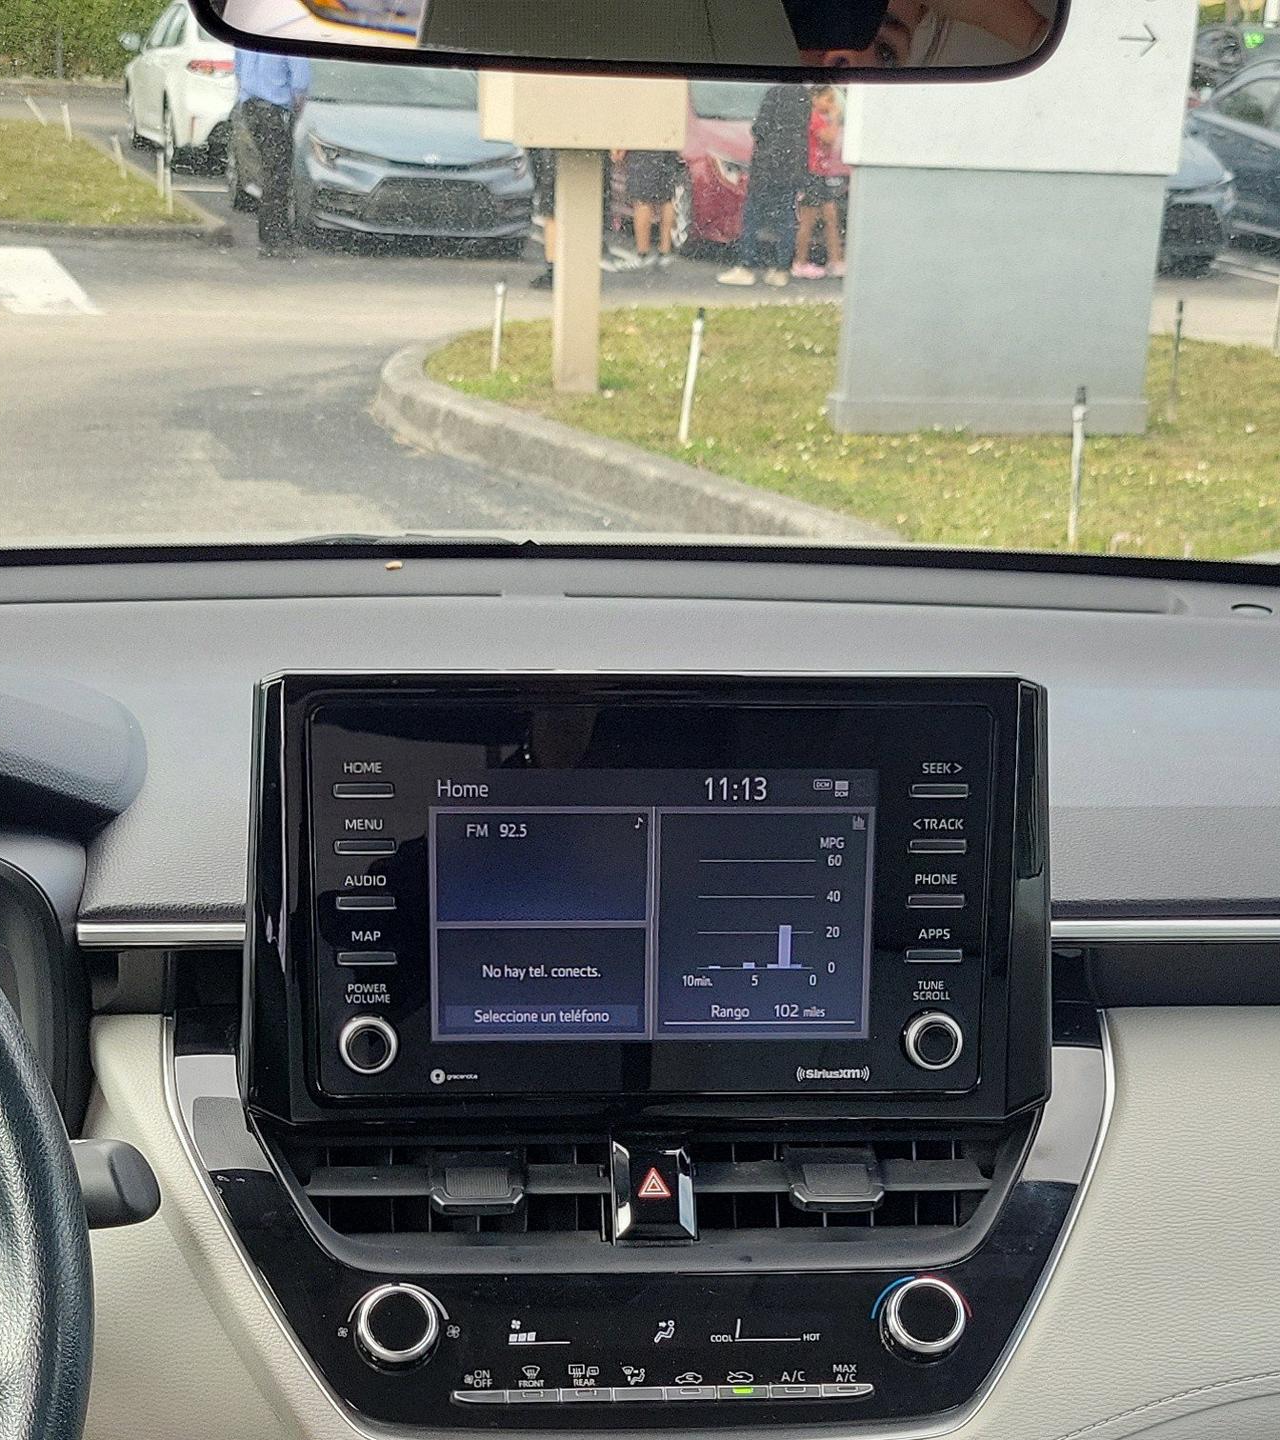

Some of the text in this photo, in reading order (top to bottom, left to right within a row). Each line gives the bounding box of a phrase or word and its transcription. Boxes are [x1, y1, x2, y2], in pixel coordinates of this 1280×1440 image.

[343, 762, 382, 774] HOME
[436, 778, 489, 798] Home
[704, 776, 768, 801] 11:13
[344, 818, 383, 831] MENU
[466, 823, 528, 838] FM 92.5
[819, 837, 845, 850] MPG
[827, 854, 842, 867] 60
[344, 875, 387, 887] AUDIO
[914, 873, 958, 885] PHONE
[826, 890, 841, 902] 40
[351, 931, 382, 942] MAP
[825, 926, 840, 938] 20
[918, 928, 951, 940] APPS
[482, 964, 602, 981] No hay tel. conects.
[827, 961, 836, 974] 0
[682, 975, 713, 987] 10min.
[751, 975, 759, 986] 5
[809, 975, 817, 986] 0
[917, 980, 944, 990] TUNE
[347, 983, 387, 993] POWER
[345, 994, 391, 1004] VOLUME
[912, 991, 951, 1001] SCROLL
[474, 1009, 610, 1023] Seleccione un teléfono
[710, 1004, 826, 1021] Rango 102 miles
[710, 1334, 733, 1343] COOL
[802, 1332, 820, 1342] HOT
[474, 1369, 491, 1379] ON
[832, 1364, 857, 1373] MAX
[573, 1378, 596, 1387] REAR
[781, 1371, 806, 1383] A/C
[835, 1373, 857, 1383] A/C
[473, 1379, 493, 1388] OFF
[518, 1379, 544, 1388] FRONT
